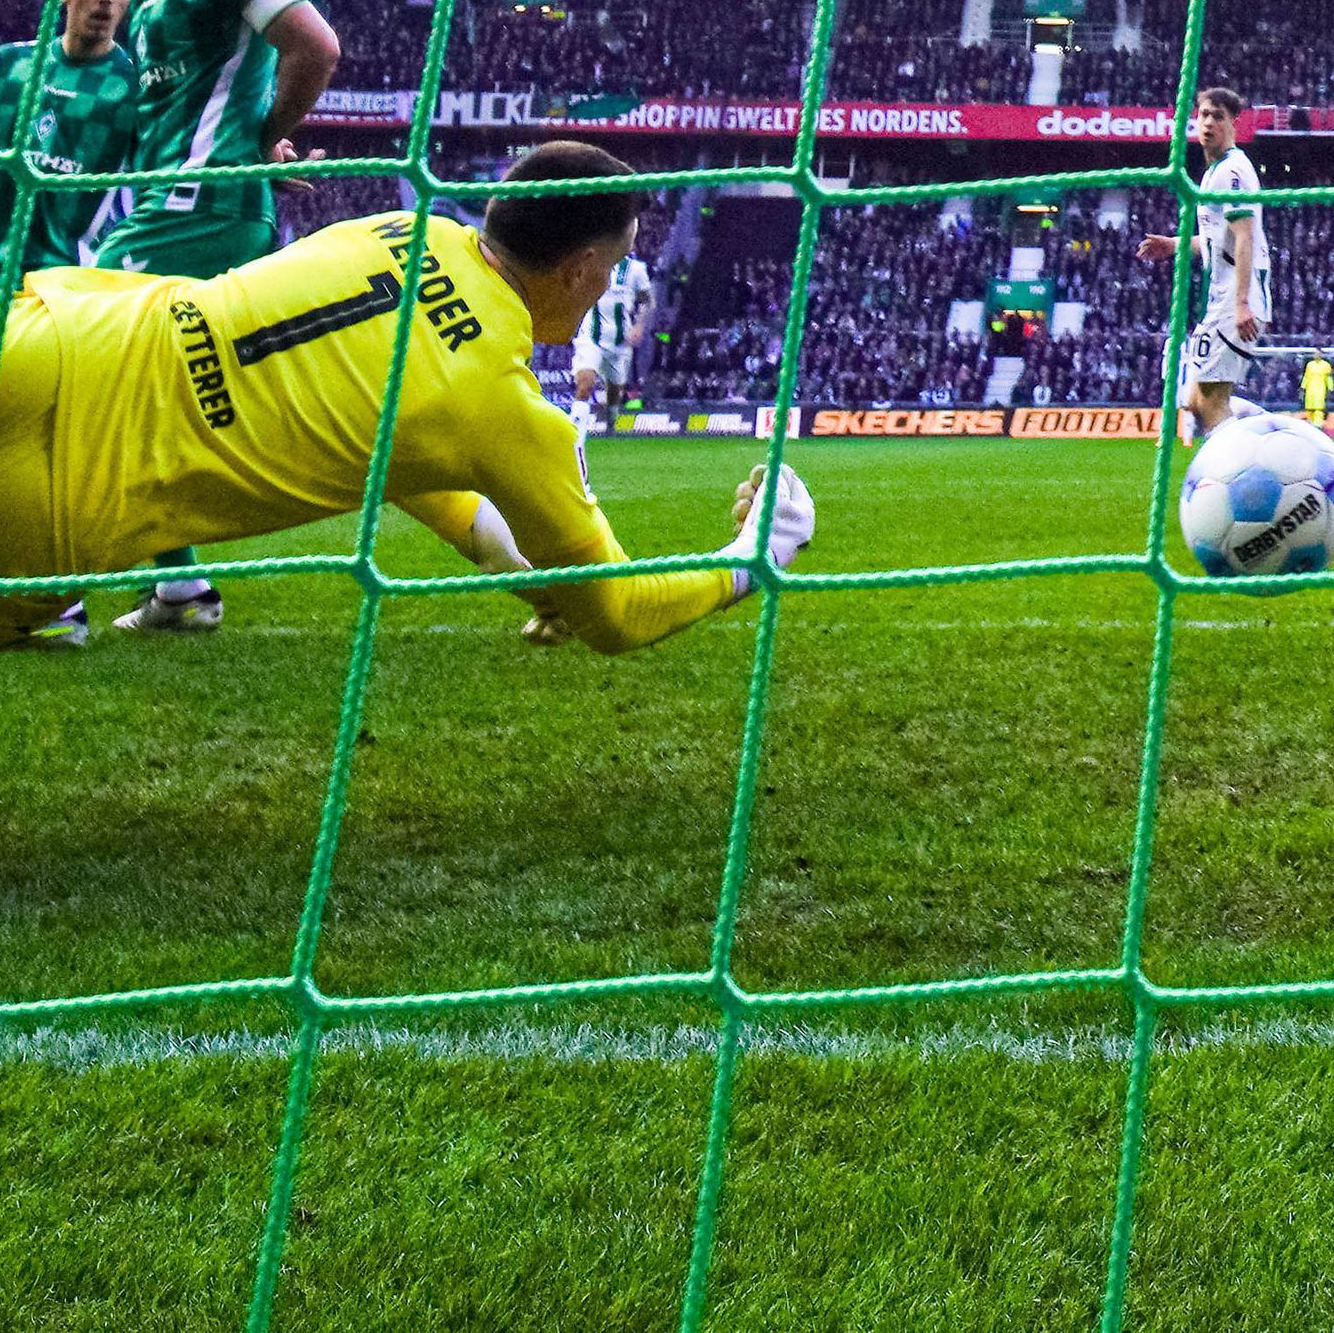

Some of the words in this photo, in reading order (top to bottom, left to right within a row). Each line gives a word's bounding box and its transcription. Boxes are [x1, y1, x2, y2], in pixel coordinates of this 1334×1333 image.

[850, 109, 968, 133] NORDENS.
[233, 270, 403, 367] 1
[169, 300, 236, 429] ZETTERER
[812, 410, 1004, 436] SKECHERS
[1021, 411, 1161, 433] FOOTBAL
[1232, 493, 1322, 564] DERBYSTAR
